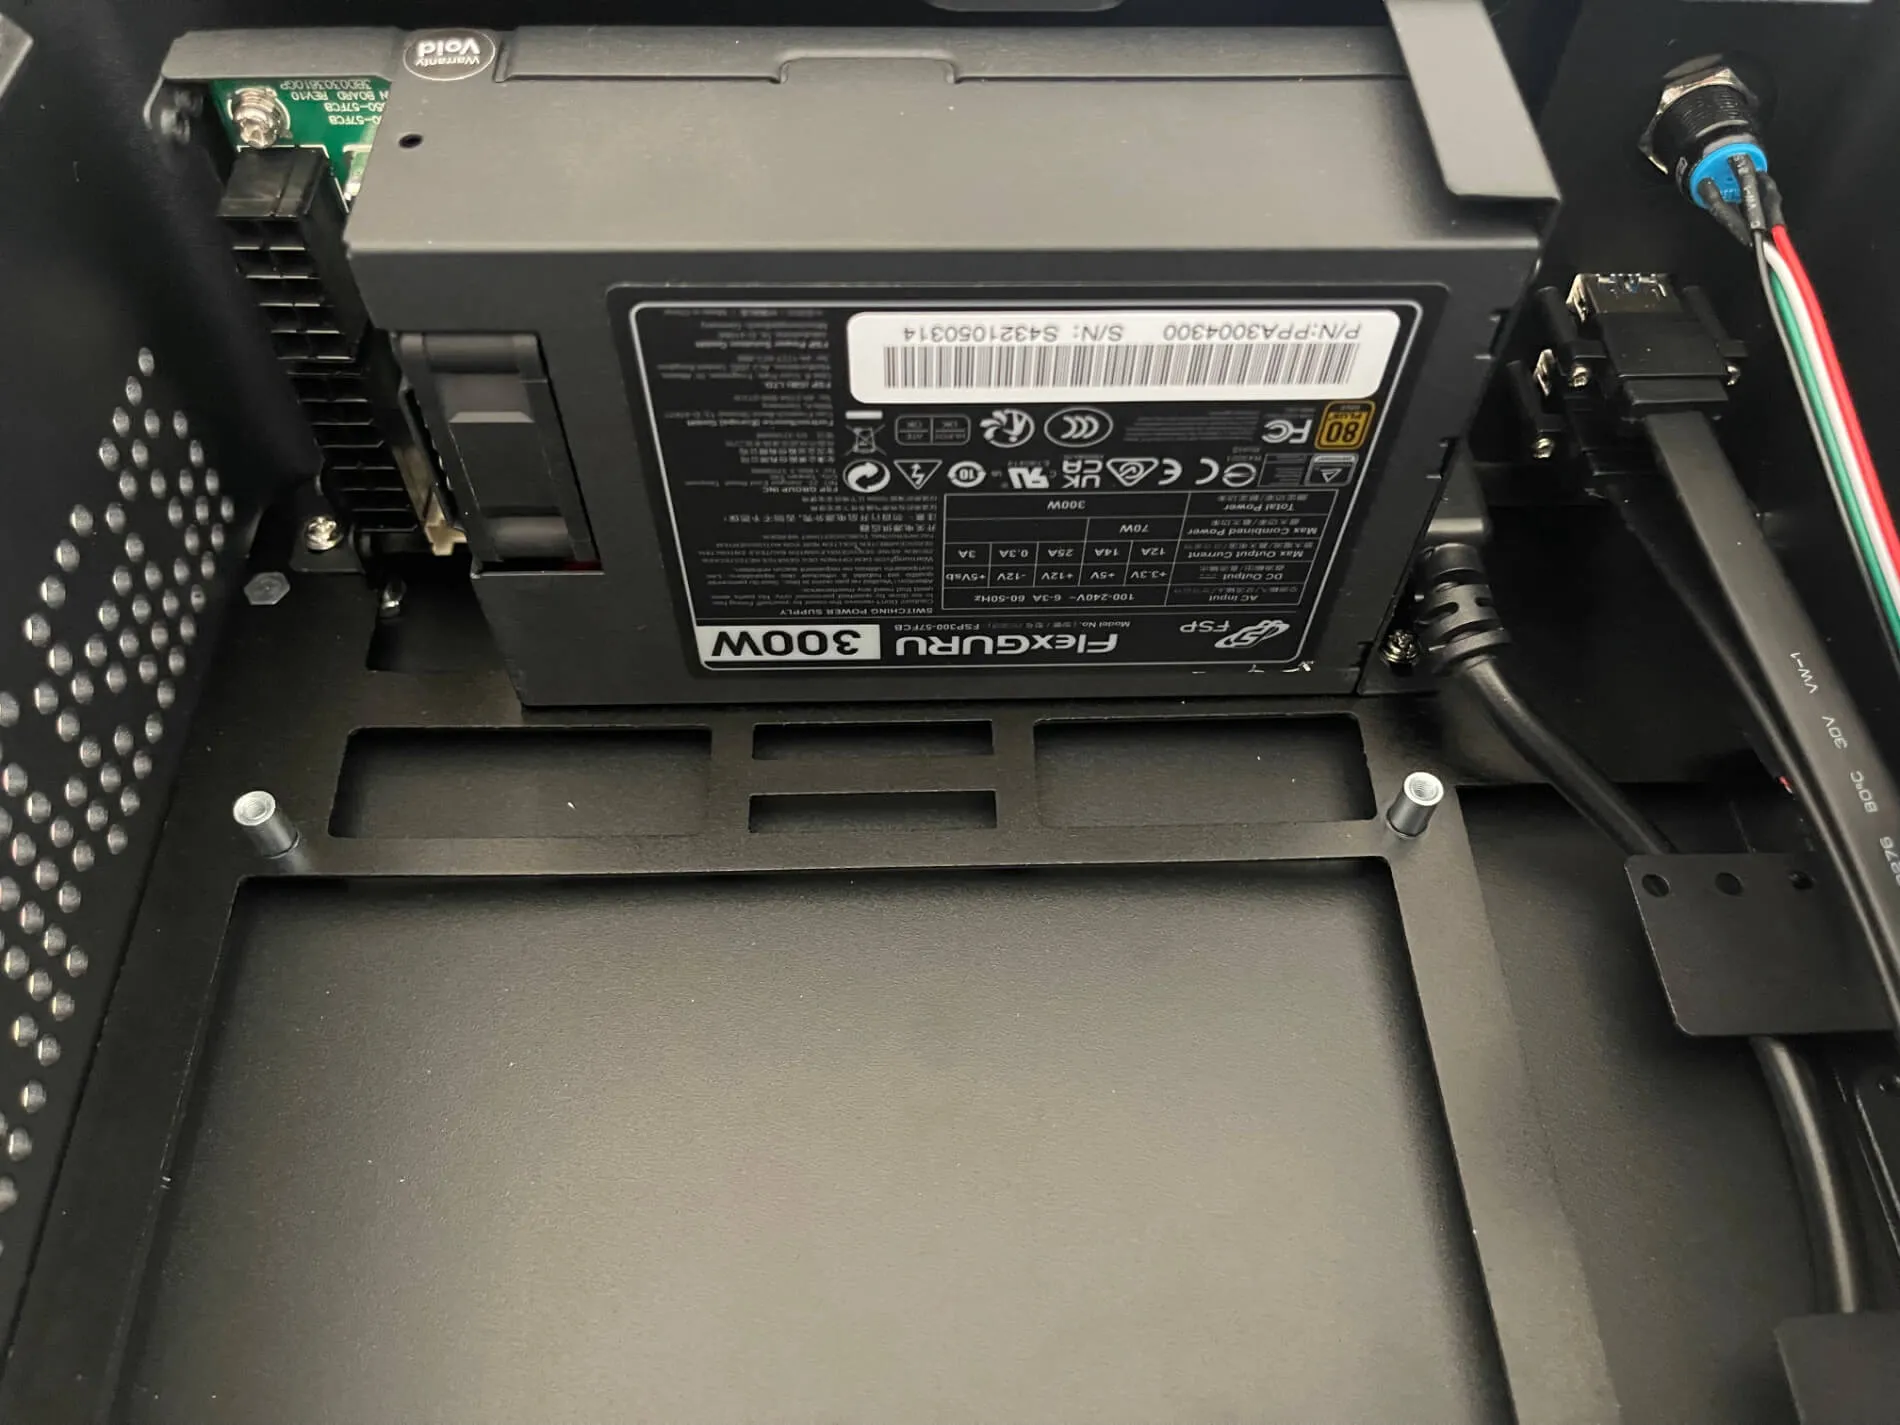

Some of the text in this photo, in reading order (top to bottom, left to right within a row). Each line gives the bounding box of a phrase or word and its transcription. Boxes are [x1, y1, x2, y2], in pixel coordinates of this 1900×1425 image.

[416, 38, 480, 58] Void
[416, 54, 480, 68] Warranty
[336, 91, 375, 100] BOARD
[324, 102, 385, 112] 50-57FCB
[328, 114, 381, 126] 0-57FCB
[902, 324, 1362, 343] P/N:PPA3004300 S/N: S4321050314
[1326, 421, 1360, 444] 80
[1046, 500, 1086, 510] 300W
[1222, 502, 1294, 512] Total Power
[1120, 524, 1150, 533] 70W
[1187, 526, 1318, 536] Max Combined Power
[957, 550, 976, 558] 3A
[998, 549, 1028, 558] 0.3A
[1048, 548, 1074, 558] 25A
[1094, 548, 1120, 556] 14A
[1140, 547, 1166, 556] 12A
[1188, 549, 1304, 559] Max Output Current
[945, 572, 986, 582] +5Vsb
[996, 572, 1026, 581] -12V
[1040, 572, 1074, 580] +12V
[1090, 571, 1116, 580] +5V
[1130, 570, 1166, 579] +3.3V
[1222, 572, 1283, 581] DC Output
[974, 594, 1026, 602] 60-50Hz
[1032, 594, 1062, 602] 6-3A
[1208, 593, 1259, 602] AC Input
[779, 607, 933, 616] SWITCHING POWER SUPPLY
[894, 623, 980, 632] FSP300-57FCB
[1099, 620, 1130, 628] Model
[1179, 620, 1230, 632] FSP
[711, 630, 862, 656] 300W
[896, 634, 1119, 656] FlexGURU
[1790, 652, 1818, 694] VW-1
[1822, 714, 1848, 750] 30V
